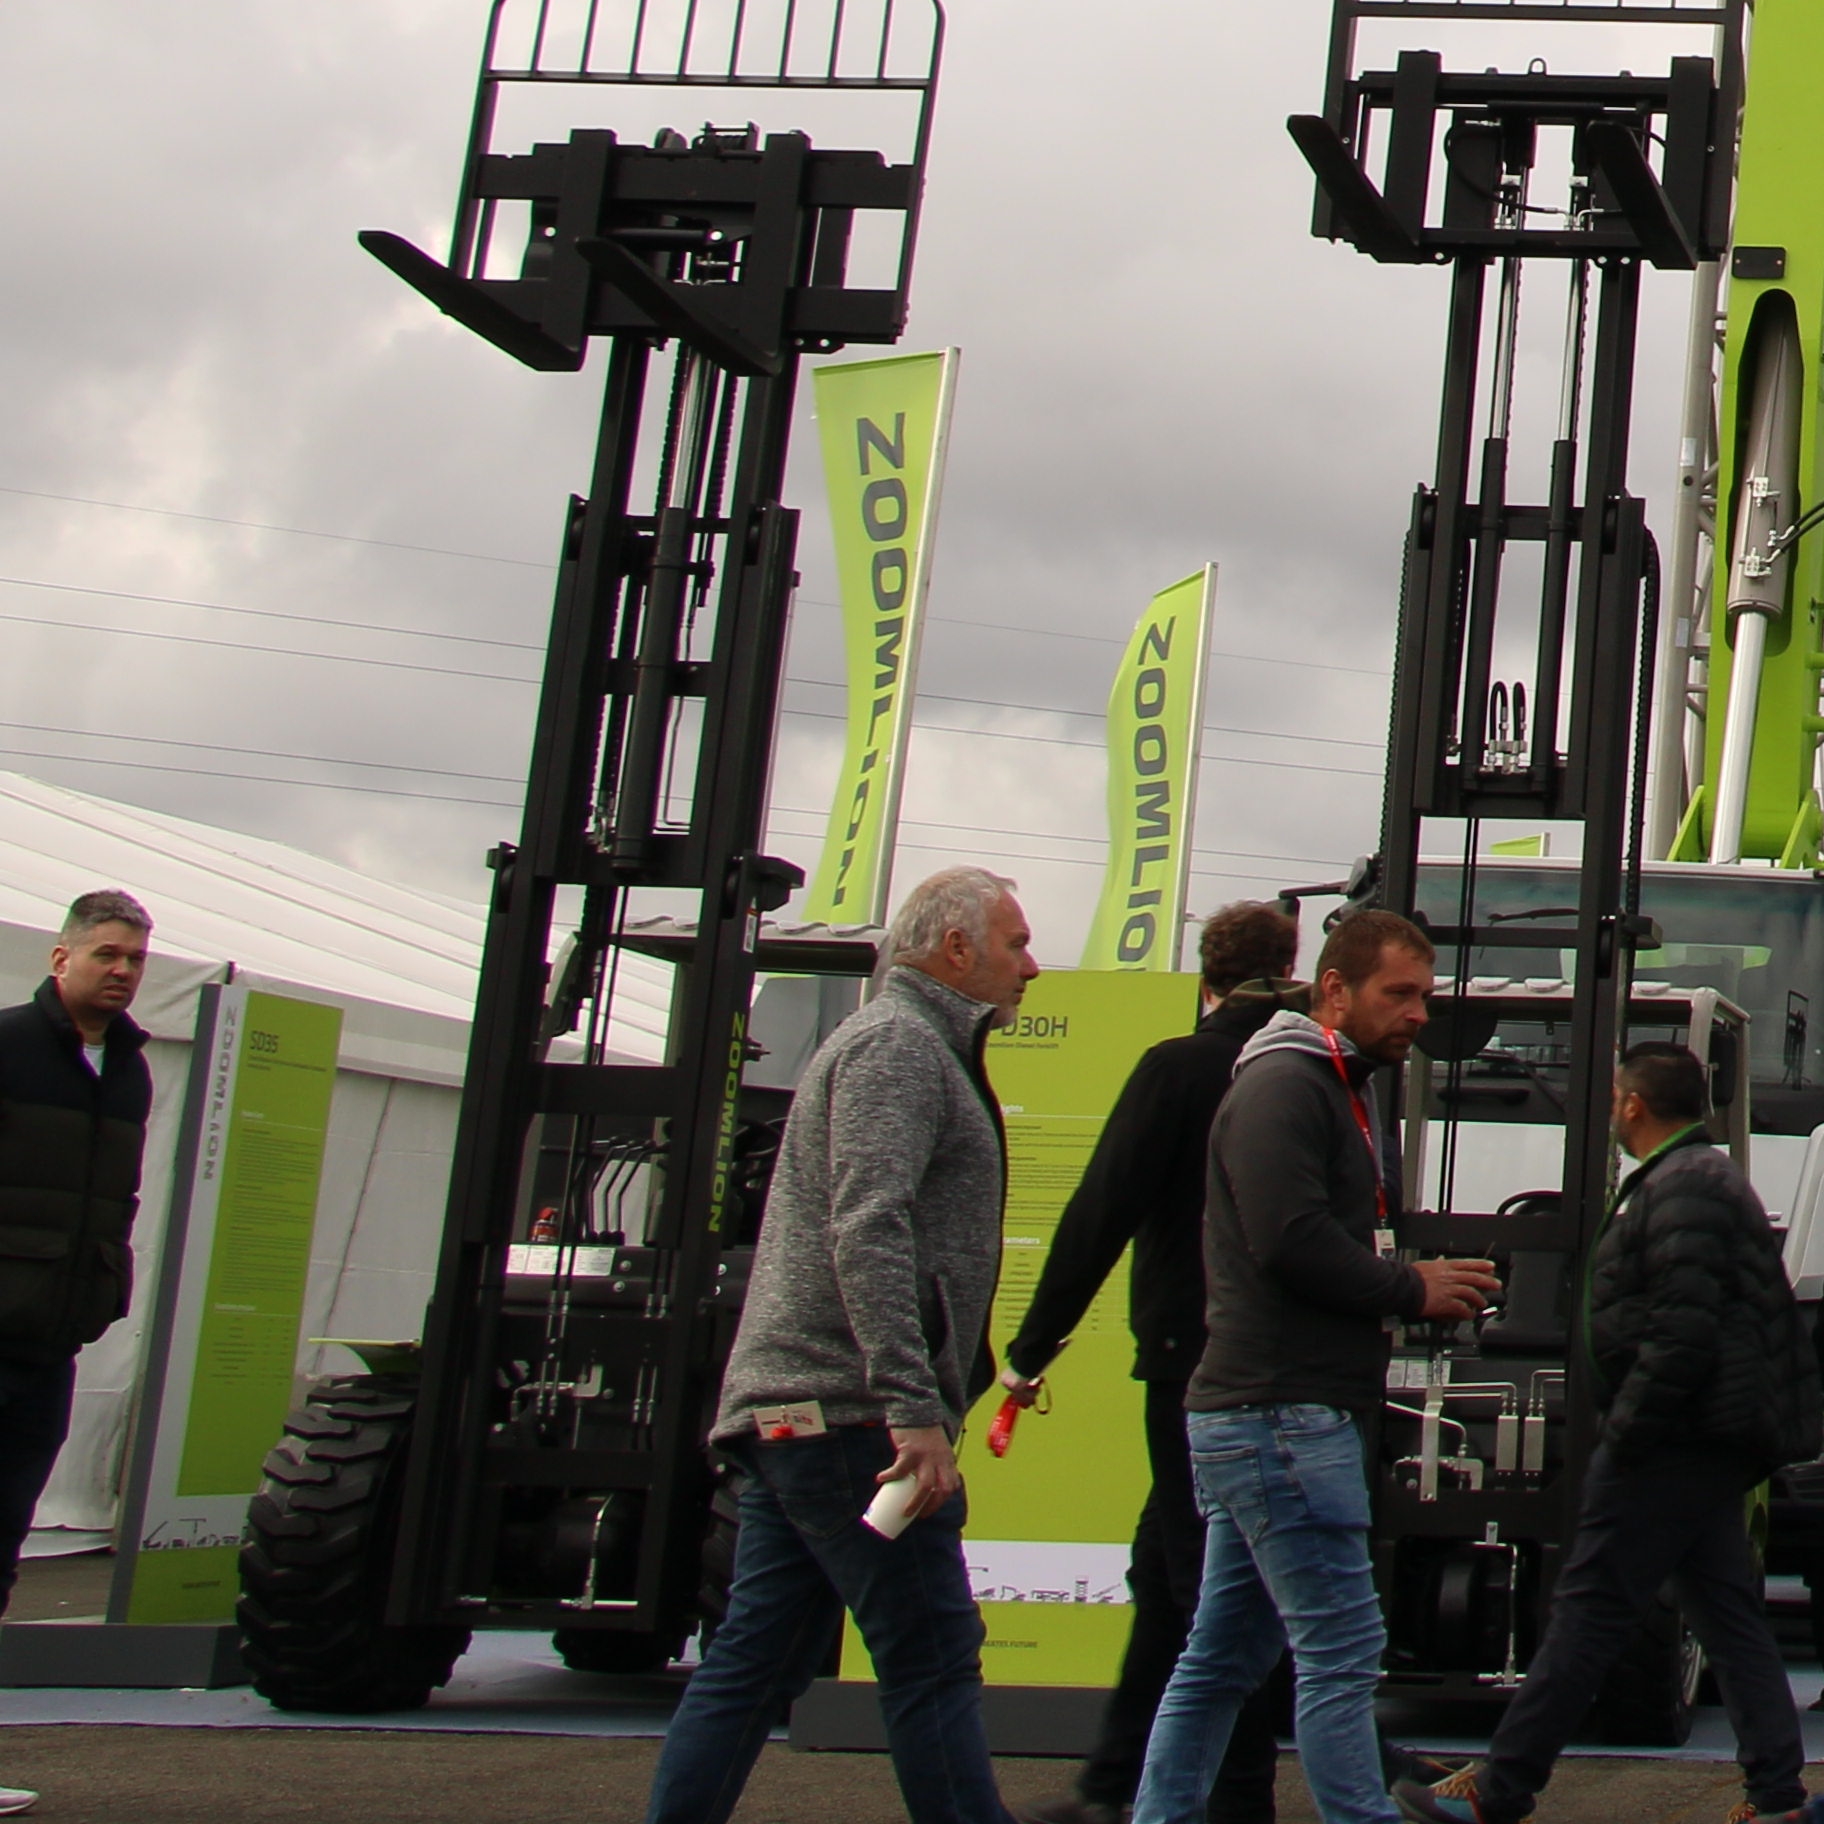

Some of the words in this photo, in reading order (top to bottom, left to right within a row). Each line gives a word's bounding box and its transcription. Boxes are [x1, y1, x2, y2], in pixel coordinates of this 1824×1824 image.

[833, 411, 908, 907] ZOOMLION
[1117, 614, 1177, 972] ZOOMLIO
[708, 1011, 745, 1232] ZOOMLION
